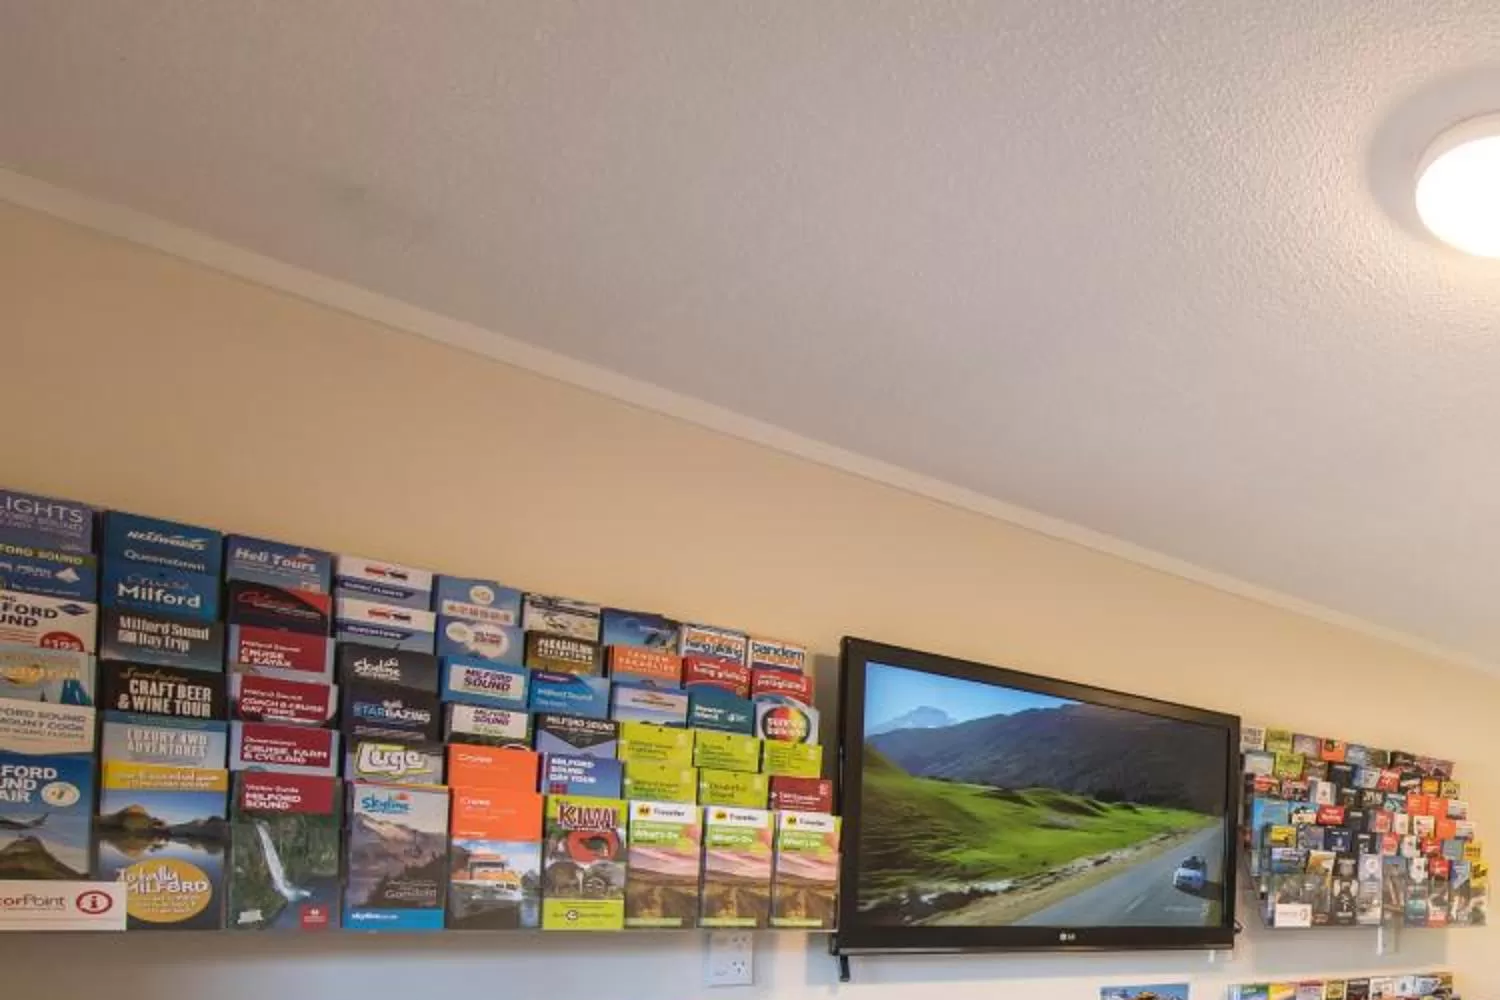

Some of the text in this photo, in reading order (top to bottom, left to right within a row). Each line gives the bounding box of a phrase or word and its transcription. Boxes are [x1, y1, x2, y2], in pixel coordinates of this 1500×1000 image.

[0, 495, 83, 524] IGHTS
[235, 548, 316, 572] Heli Tours
[117, 581, 201, 609] Milford
[120, 615, 170, 634] Milford
[129, 678, 212, 701] CRAFT BEER
[117, 694, 211, 718] & WINE TOUR
[2, 764, 58, 780] FORD
